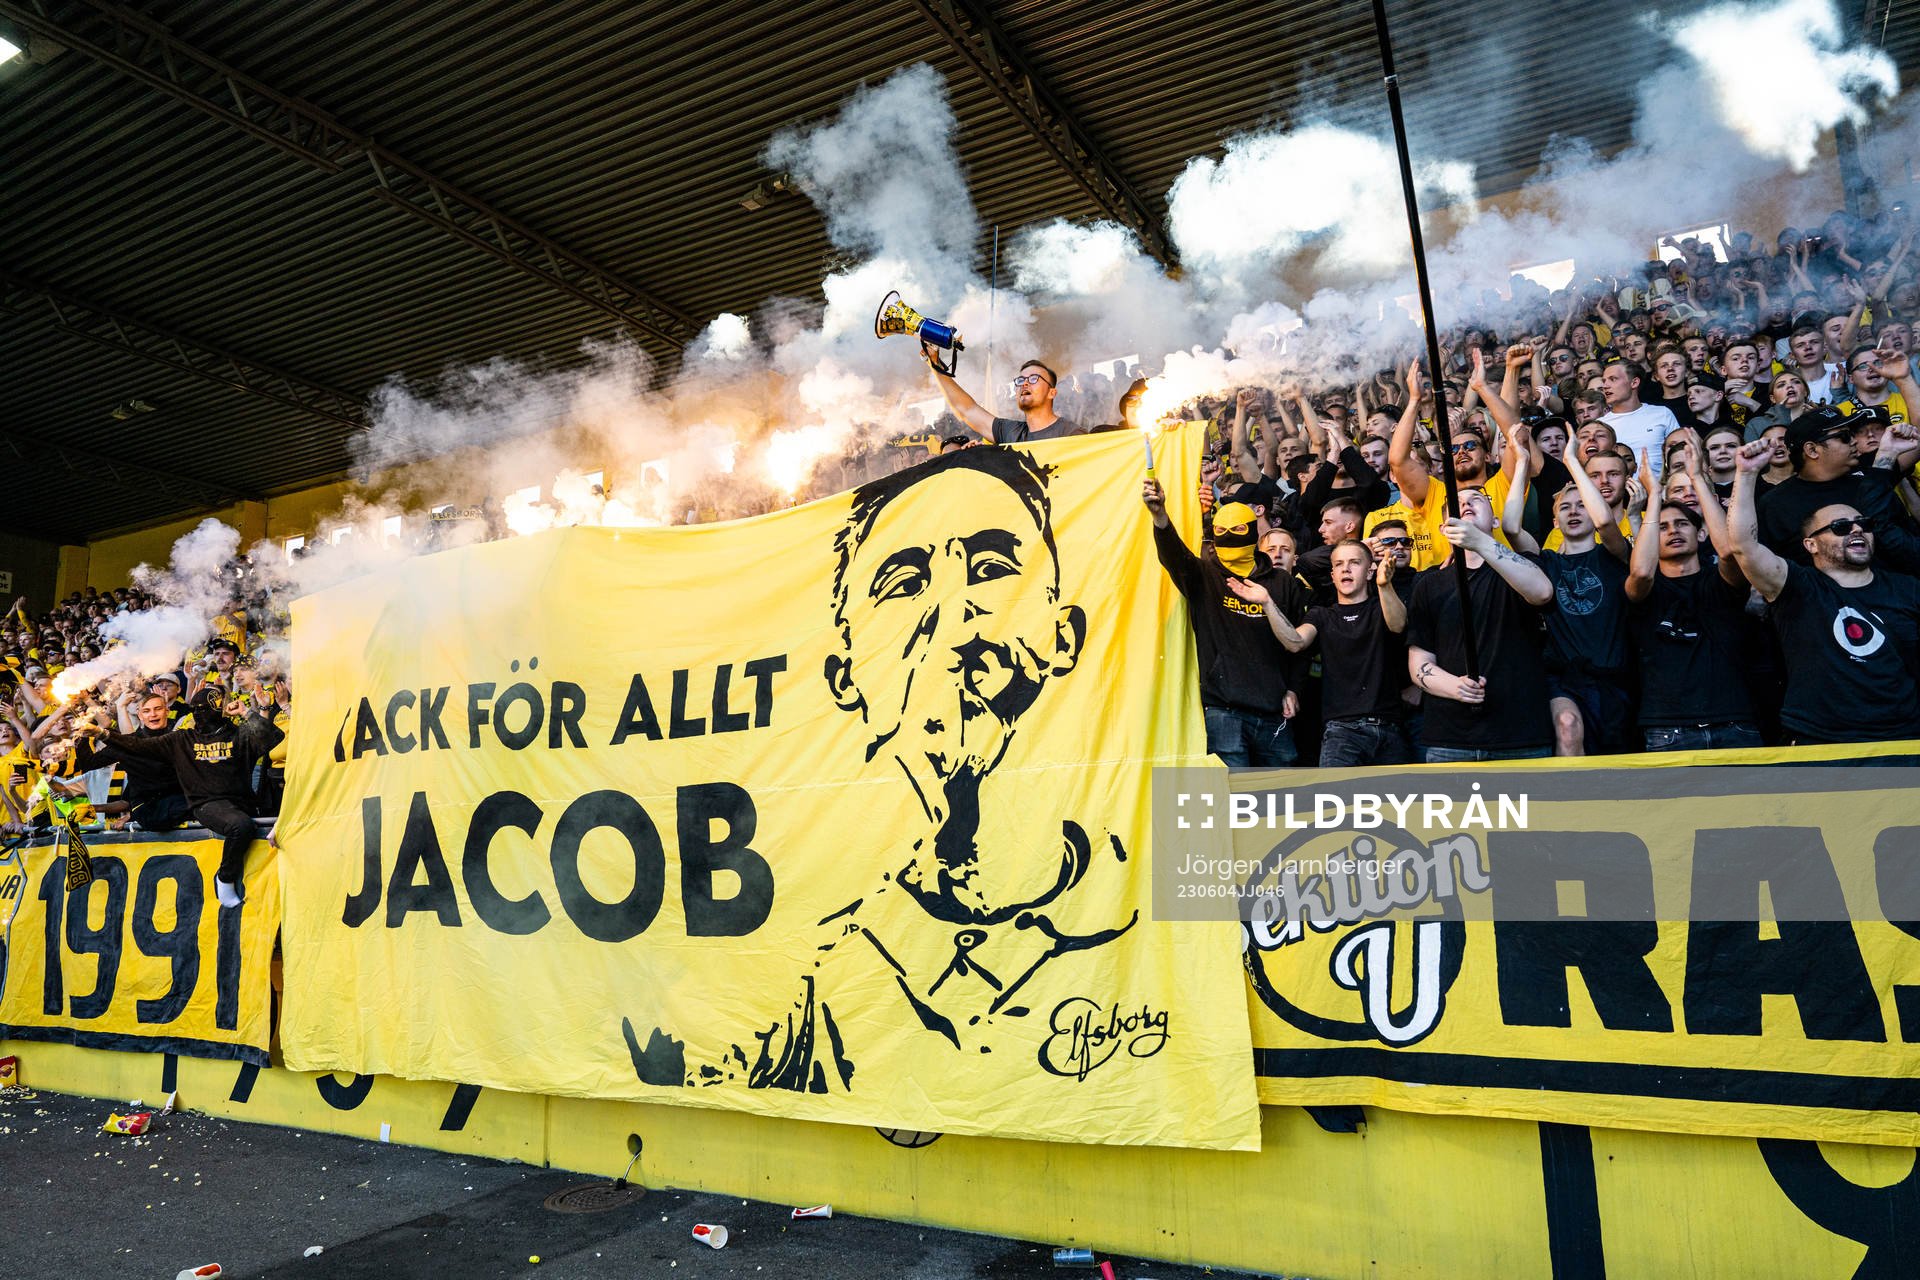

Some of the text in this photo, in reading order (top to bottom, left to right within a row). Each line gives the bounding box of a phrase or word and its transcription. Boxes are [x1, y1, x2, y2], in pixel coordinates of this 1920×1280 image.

[468, 656, 588, 751] FÖR
[609, 653, 788, 746] ALLT
[342, 781, 775, 943] JACOB
[1241, 835, 1490, 955] ektion
[38, 854, 244, 1031] 1991
[1037, 996, 1172, 1083] Elfsborg
